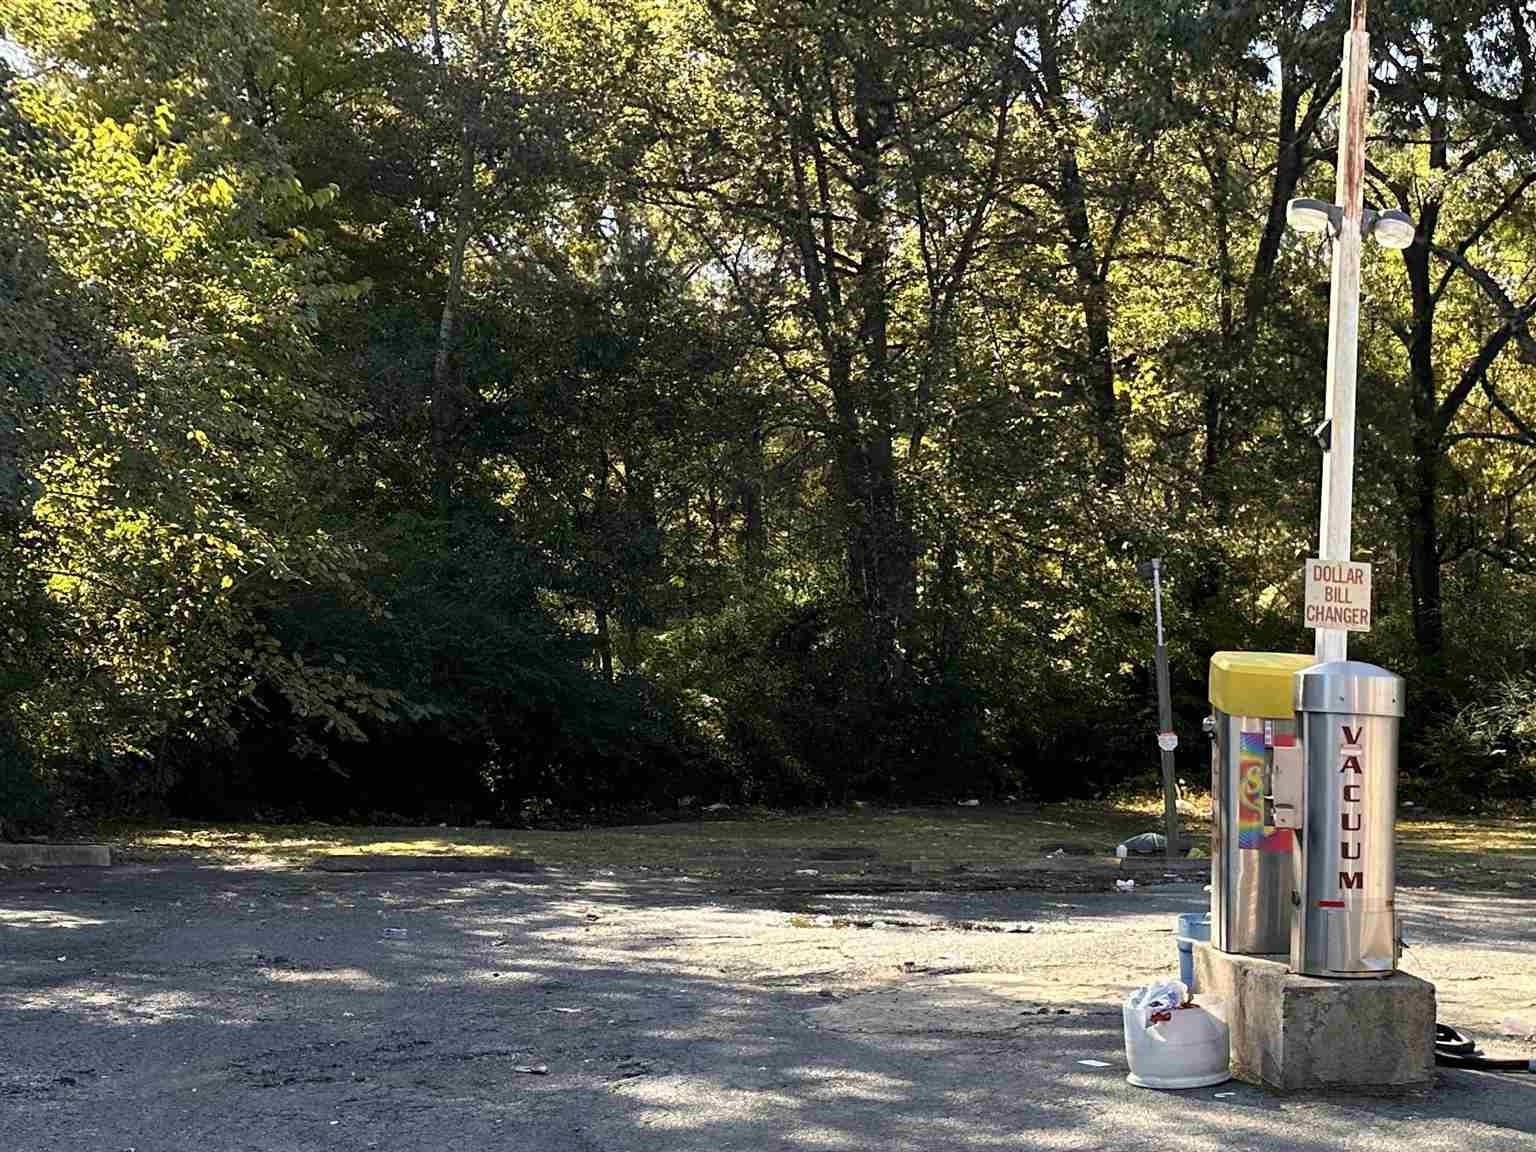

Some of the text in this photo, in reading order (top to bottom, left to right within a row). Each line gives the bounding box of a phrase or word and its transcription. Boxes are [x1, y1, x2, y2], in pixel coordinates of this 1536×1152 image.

[1313, 565, 1364, 585] DOLLAR
[1325, 586, 1352, 604] BILL
[1306, 604, 1369, 625] CHANGER
[1339, 726, 1364, 889] VACUUM
